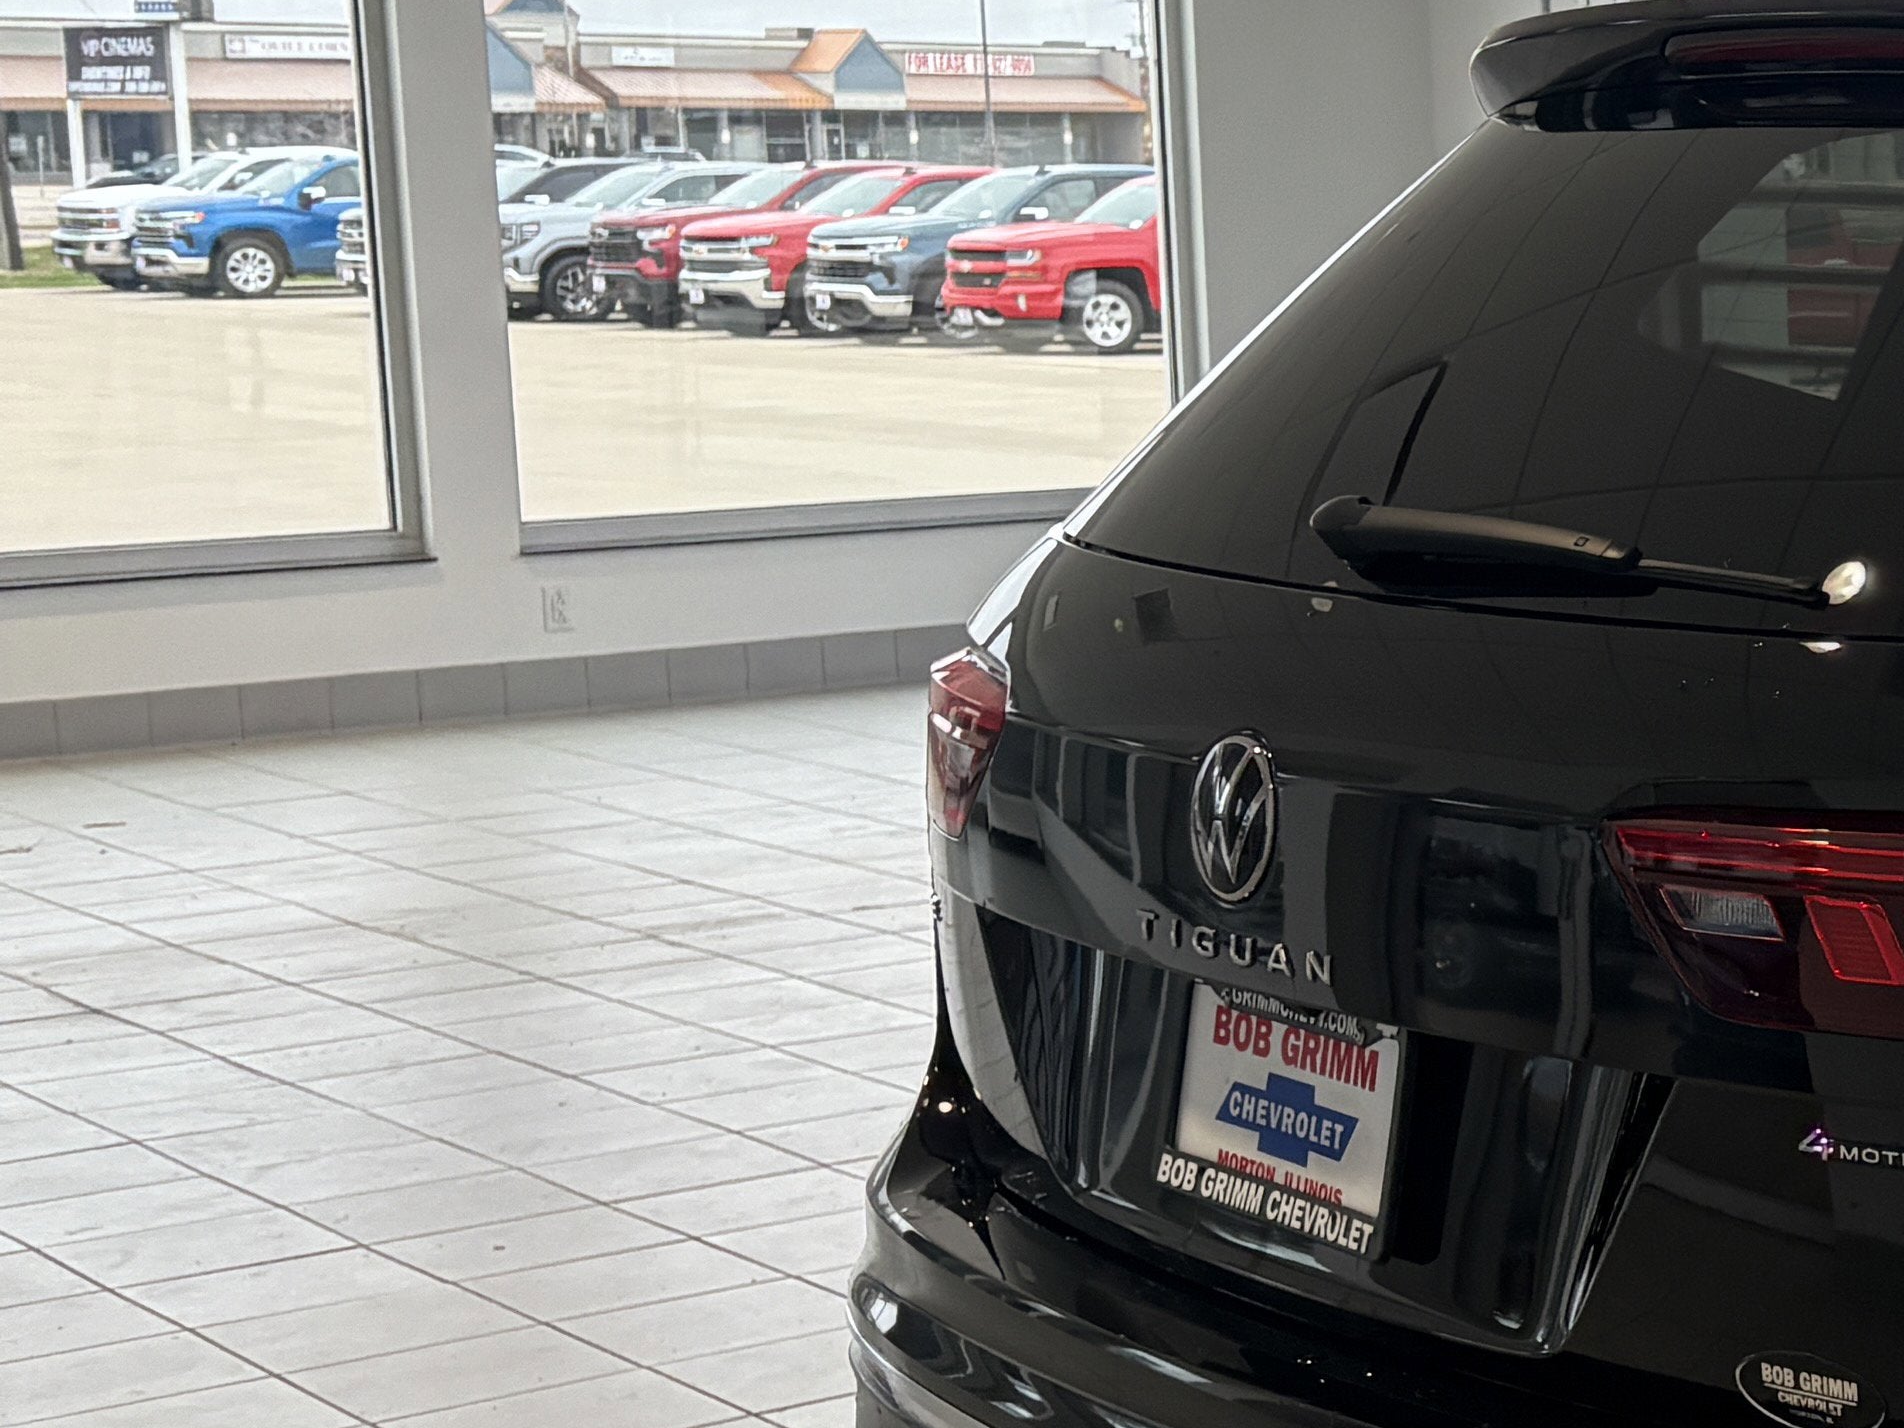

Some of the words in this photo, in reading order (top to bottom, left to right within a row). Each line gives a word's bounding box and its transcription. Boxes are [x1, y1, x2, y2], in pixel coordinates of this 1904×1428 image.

[1136, 908, 1332, 987] TIGUAN
[1213, 1004, 1273, 1059] BOB
[1281, 1025, 1379, 1093] GRIMM
[1229, 1090, 1344, 1151] CHEVROLET
[1156, 1152, 1198, 1192] BOB
[1200, 1167, 1265, 1216] GRIMM
[1266, 1190, 1374, 1255] CHEVROLET
[1217, 1148, 1276, 1183] MORTON
[1284, 1170, 1344, 1206] ILLINOIS
[1761, 1362, 1795, 1388] BOB
[1800, 1372, 1859, 1402] GRIMM
[1777, 1390, 1843, 1417] CHEVROLET
